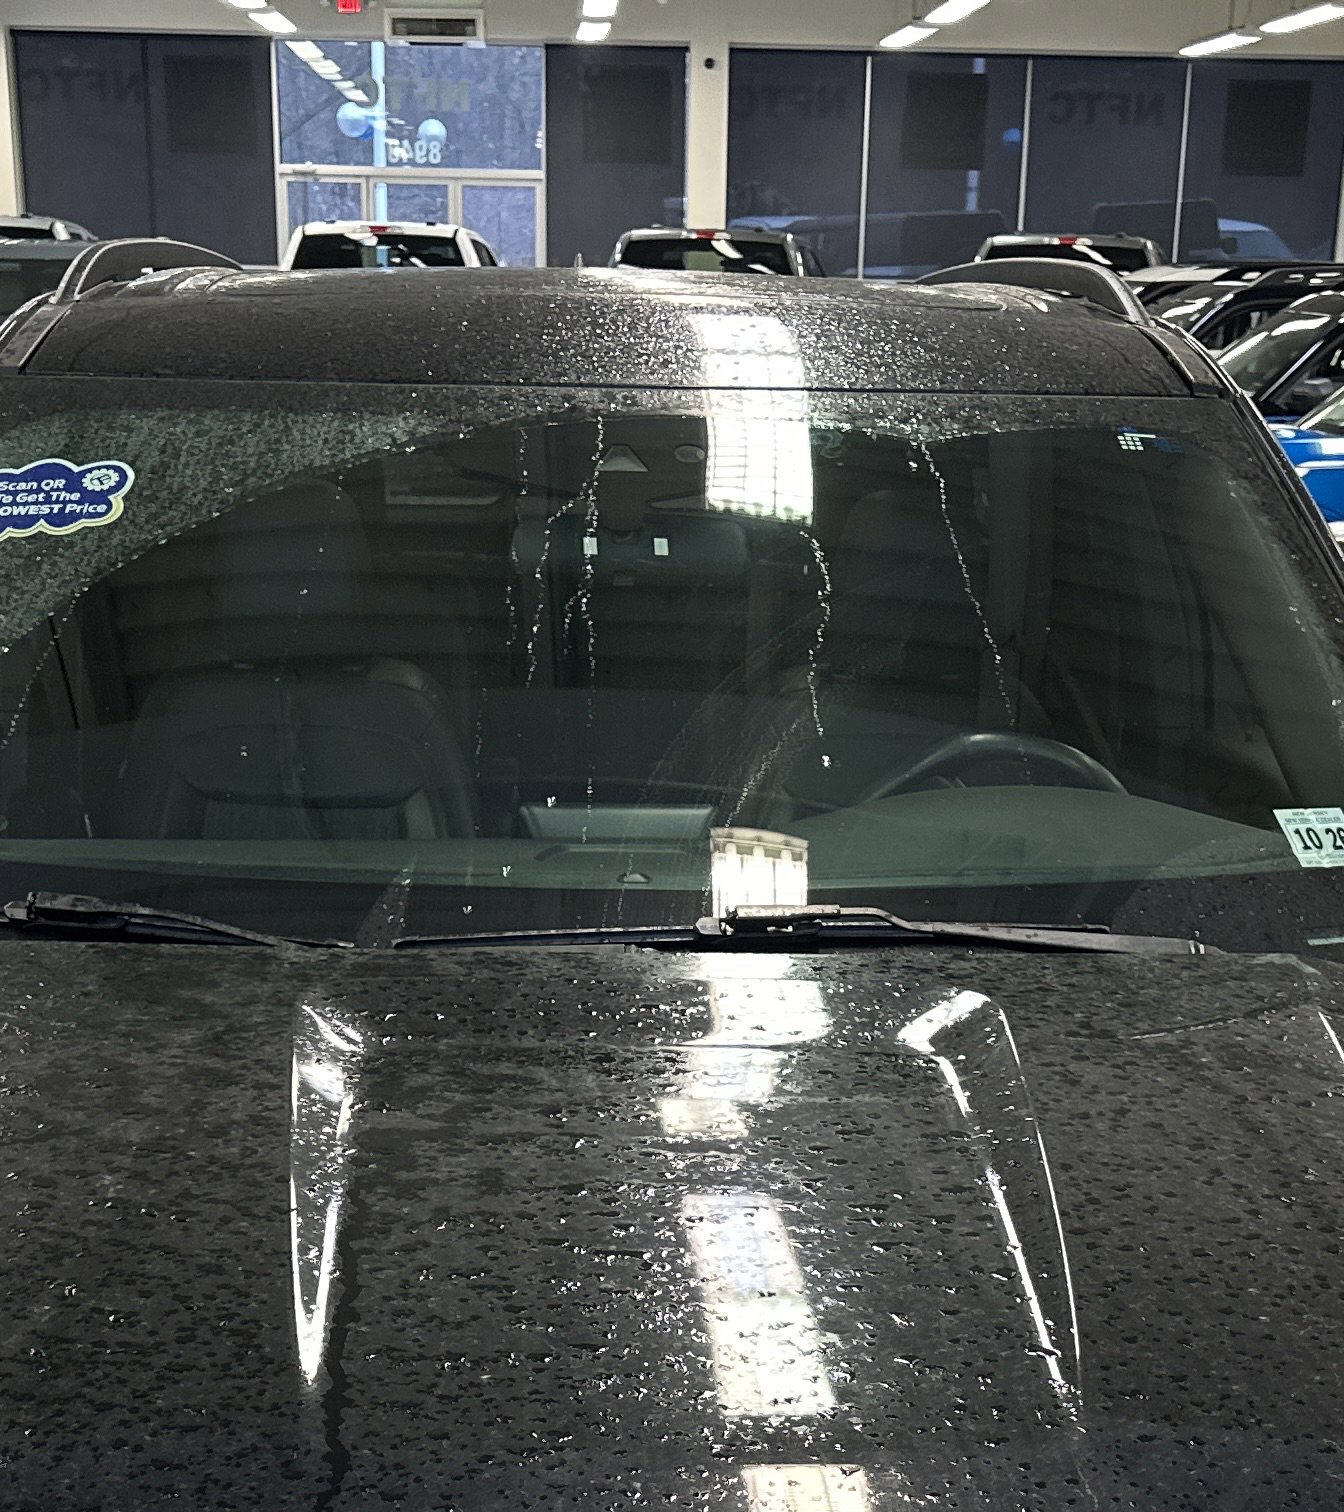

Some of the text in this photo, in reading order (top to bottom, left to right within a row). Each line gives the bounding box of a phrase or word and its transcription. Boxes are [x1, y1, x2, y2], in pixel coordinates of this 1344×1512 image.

[40, 479, 66, 491] QR
[15, 492, 46, 503] Get
[50, 491, 81, 502] The
[64, 503, 108, 515] Price
[1294, 827, 1324, 851] 10
